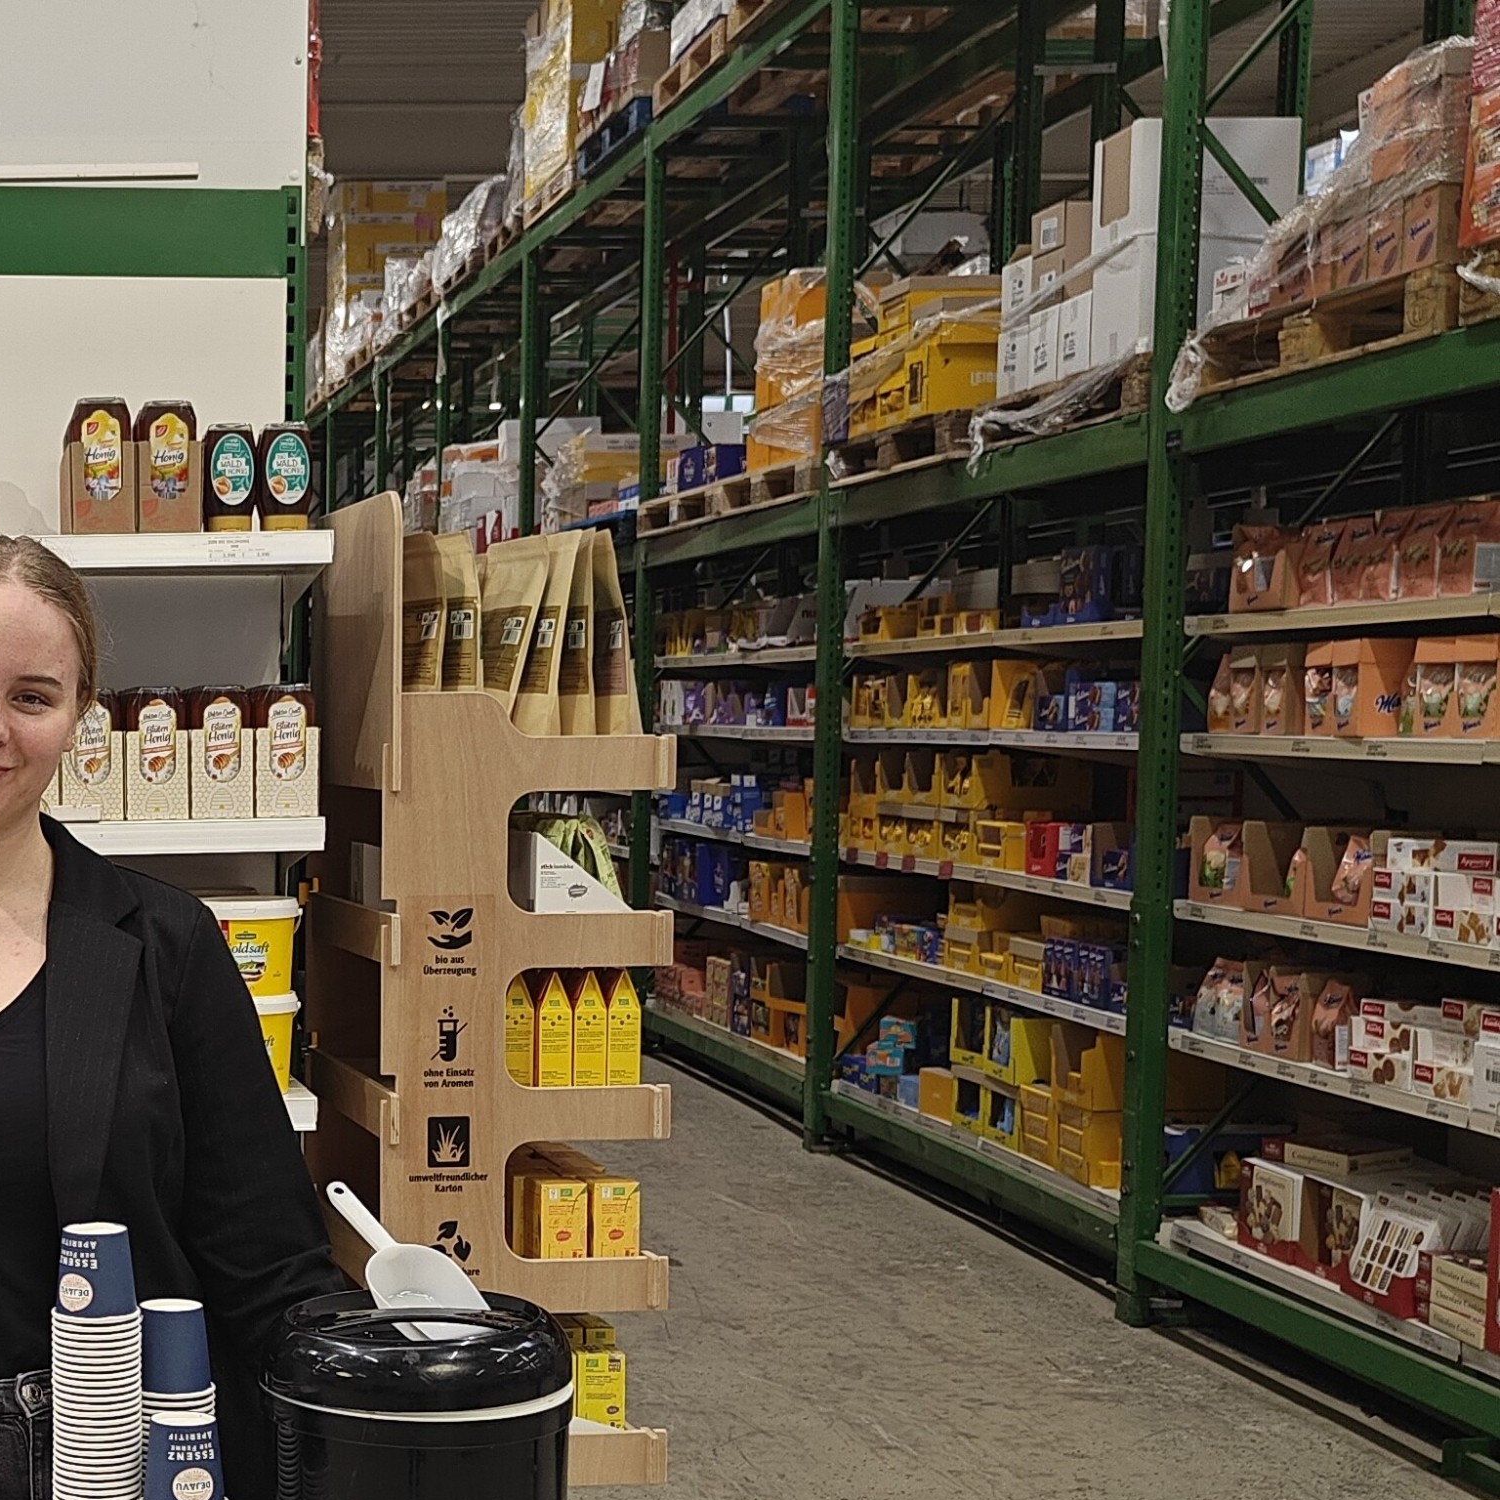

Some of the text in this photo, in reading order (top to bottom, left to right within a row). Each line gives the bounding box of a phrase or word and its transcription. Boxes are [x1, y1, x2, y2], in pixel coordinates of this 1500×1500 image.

[85, 449, 116, 463] Honig
[153, 450, 184, 464] Honig
[220, 460, 242, 468] WALD
[275, 459, 298, 468] WALD
[210, 722, 234, 732] Blüten
[275, 720, 299, 731] Blüten
[143, 734, 171, 747] Honig
[208, 731, 236, 743] Honig
[273, 730, 301, 742] Honig
[230, 941, 269, 953] oldsaft
[435, 955, 448, 964] bio
[423, 964, 477, 976] Überzeugung
[423, 1067, 475, 1077] ohne Einsatz
[424, 1079, 474, 1088] von Aromen
[409, 1172, 488, 1182] umweltfreundlicher
[434, 1183, 463, 1193] Karton
[167, 1449, 215, 1461] ESSENZ
